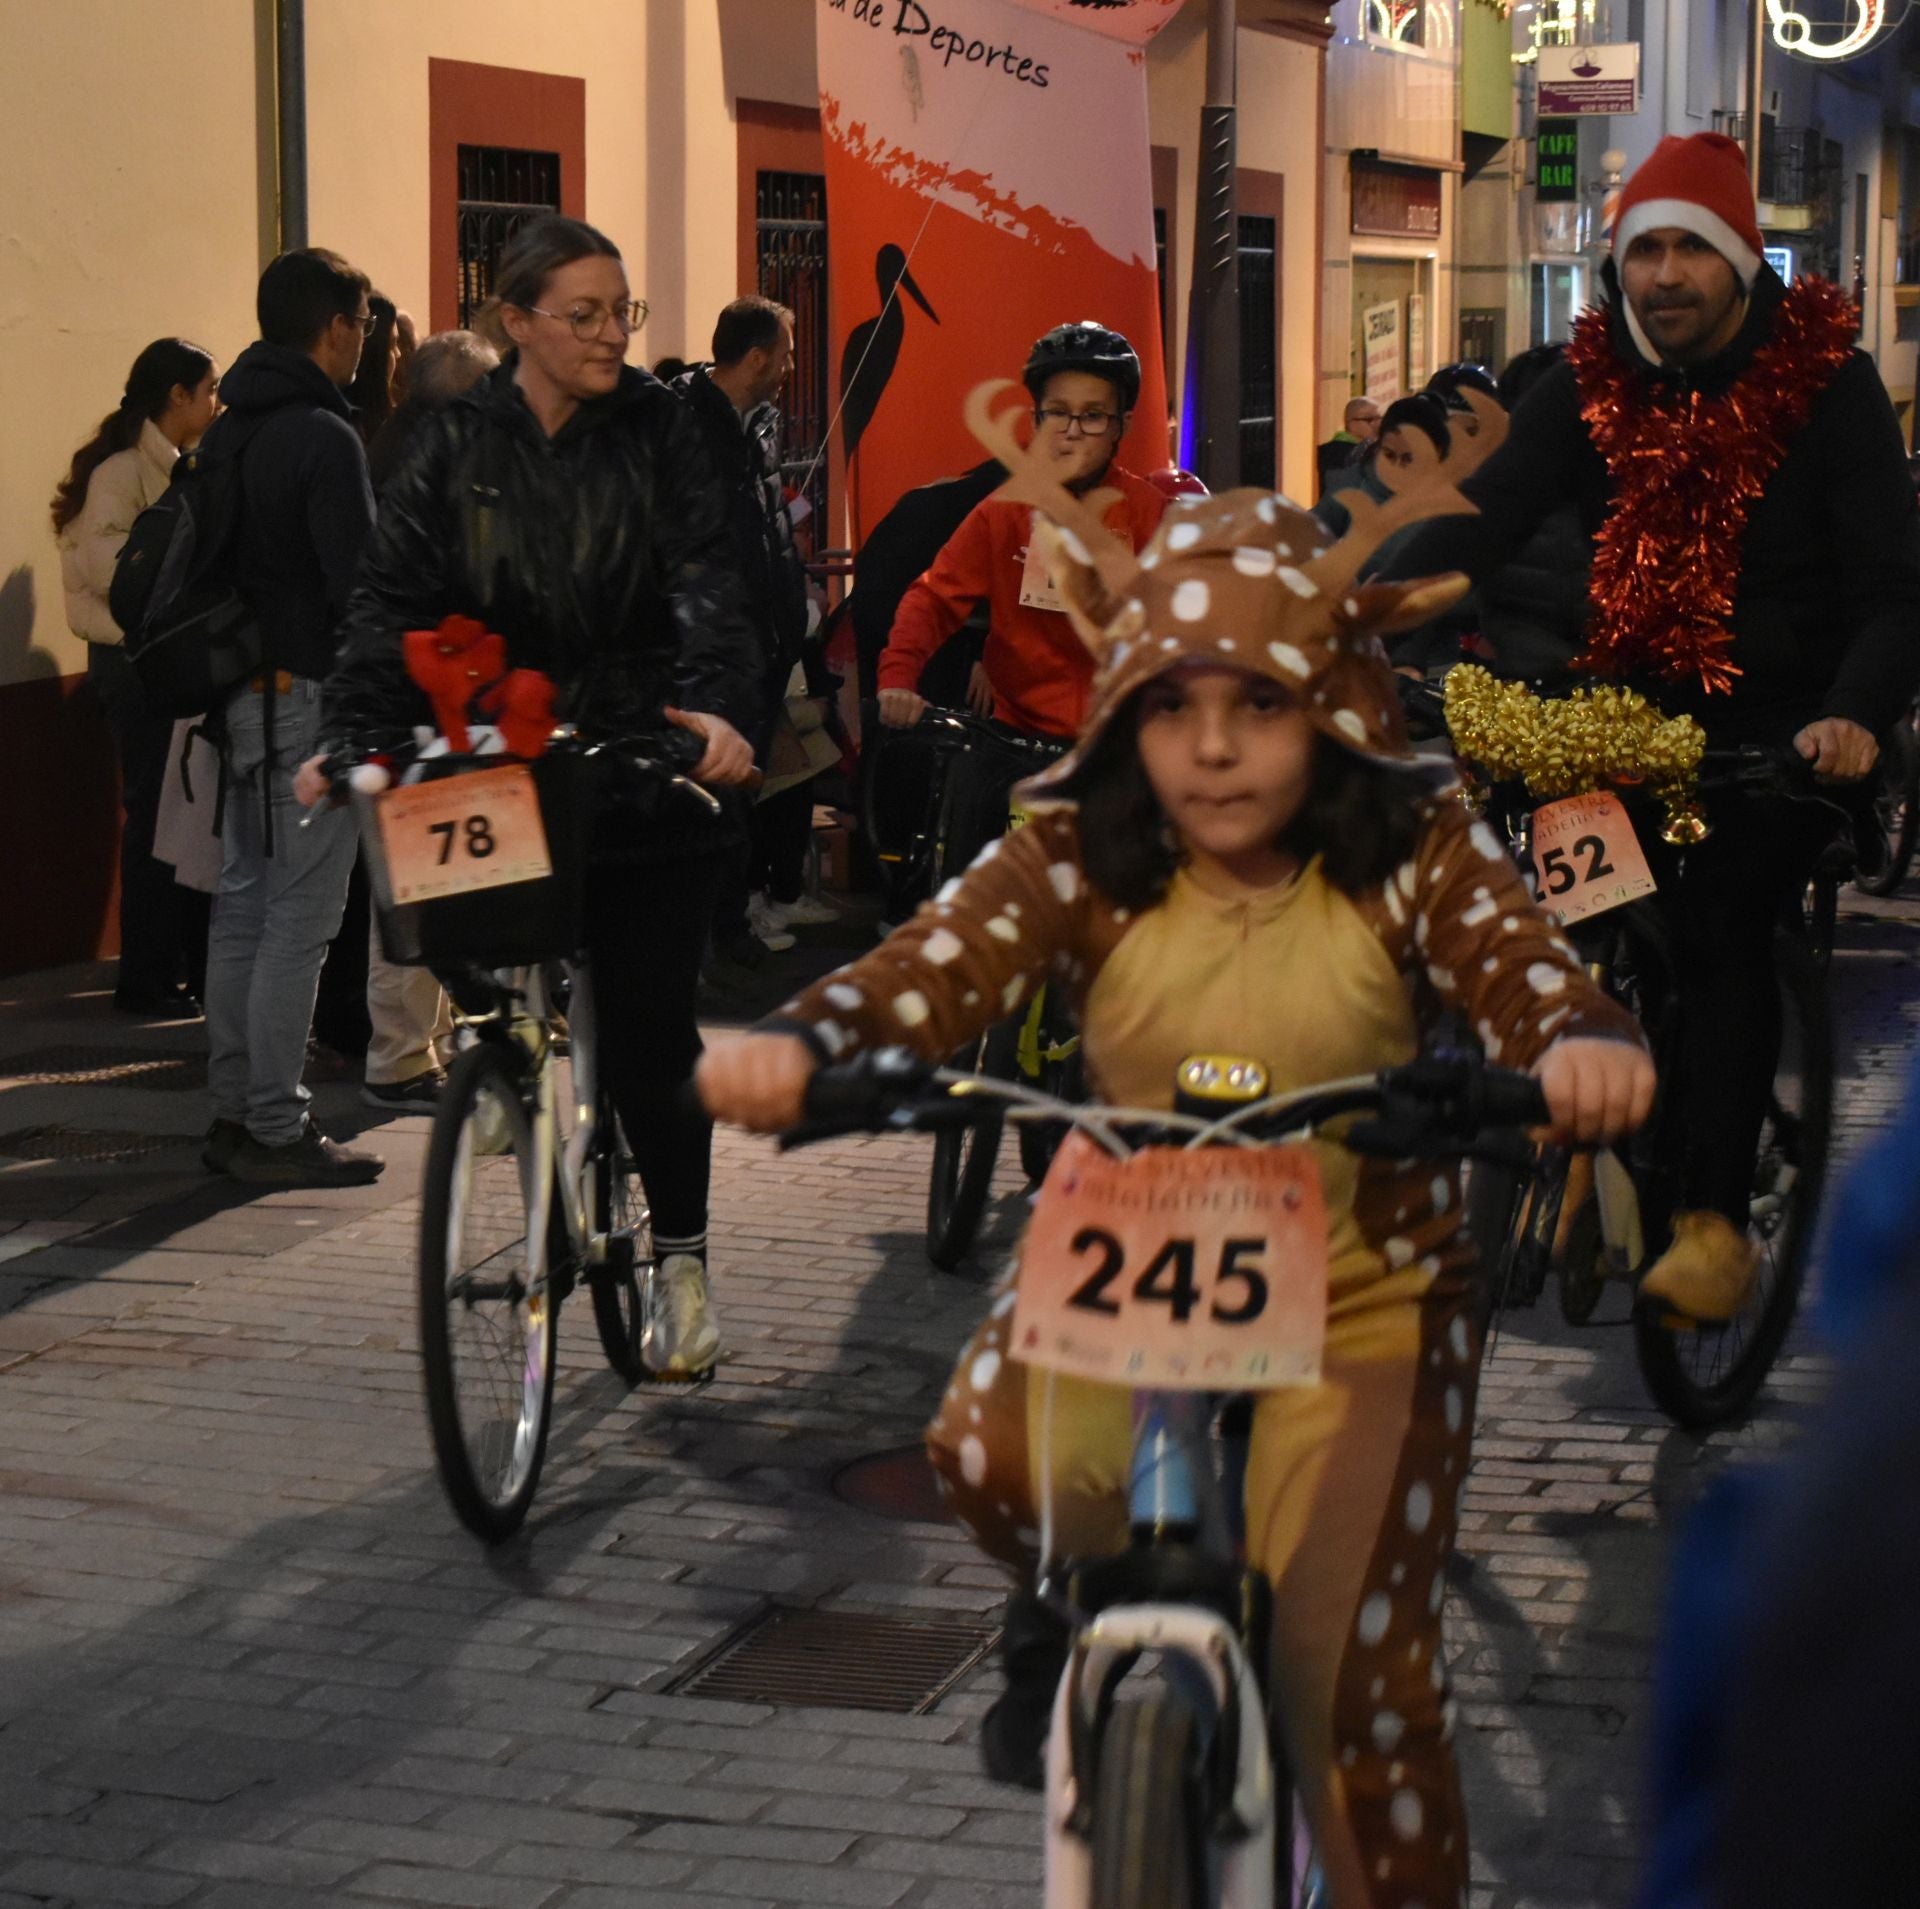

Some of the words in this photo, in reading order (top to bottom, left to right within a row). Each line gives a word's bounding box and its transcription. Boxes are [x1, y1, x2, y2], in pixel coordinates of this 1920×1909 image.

[853, 0, 883, 28] de
[893, 0, 1049, 88] Deportes
[1538, 134, 1576, 154] CAFE
[1540, 166, 1573, 187] BAR
[428, 815, 497, 866] 78
[1066, 1224, 1269, 1327] 245
